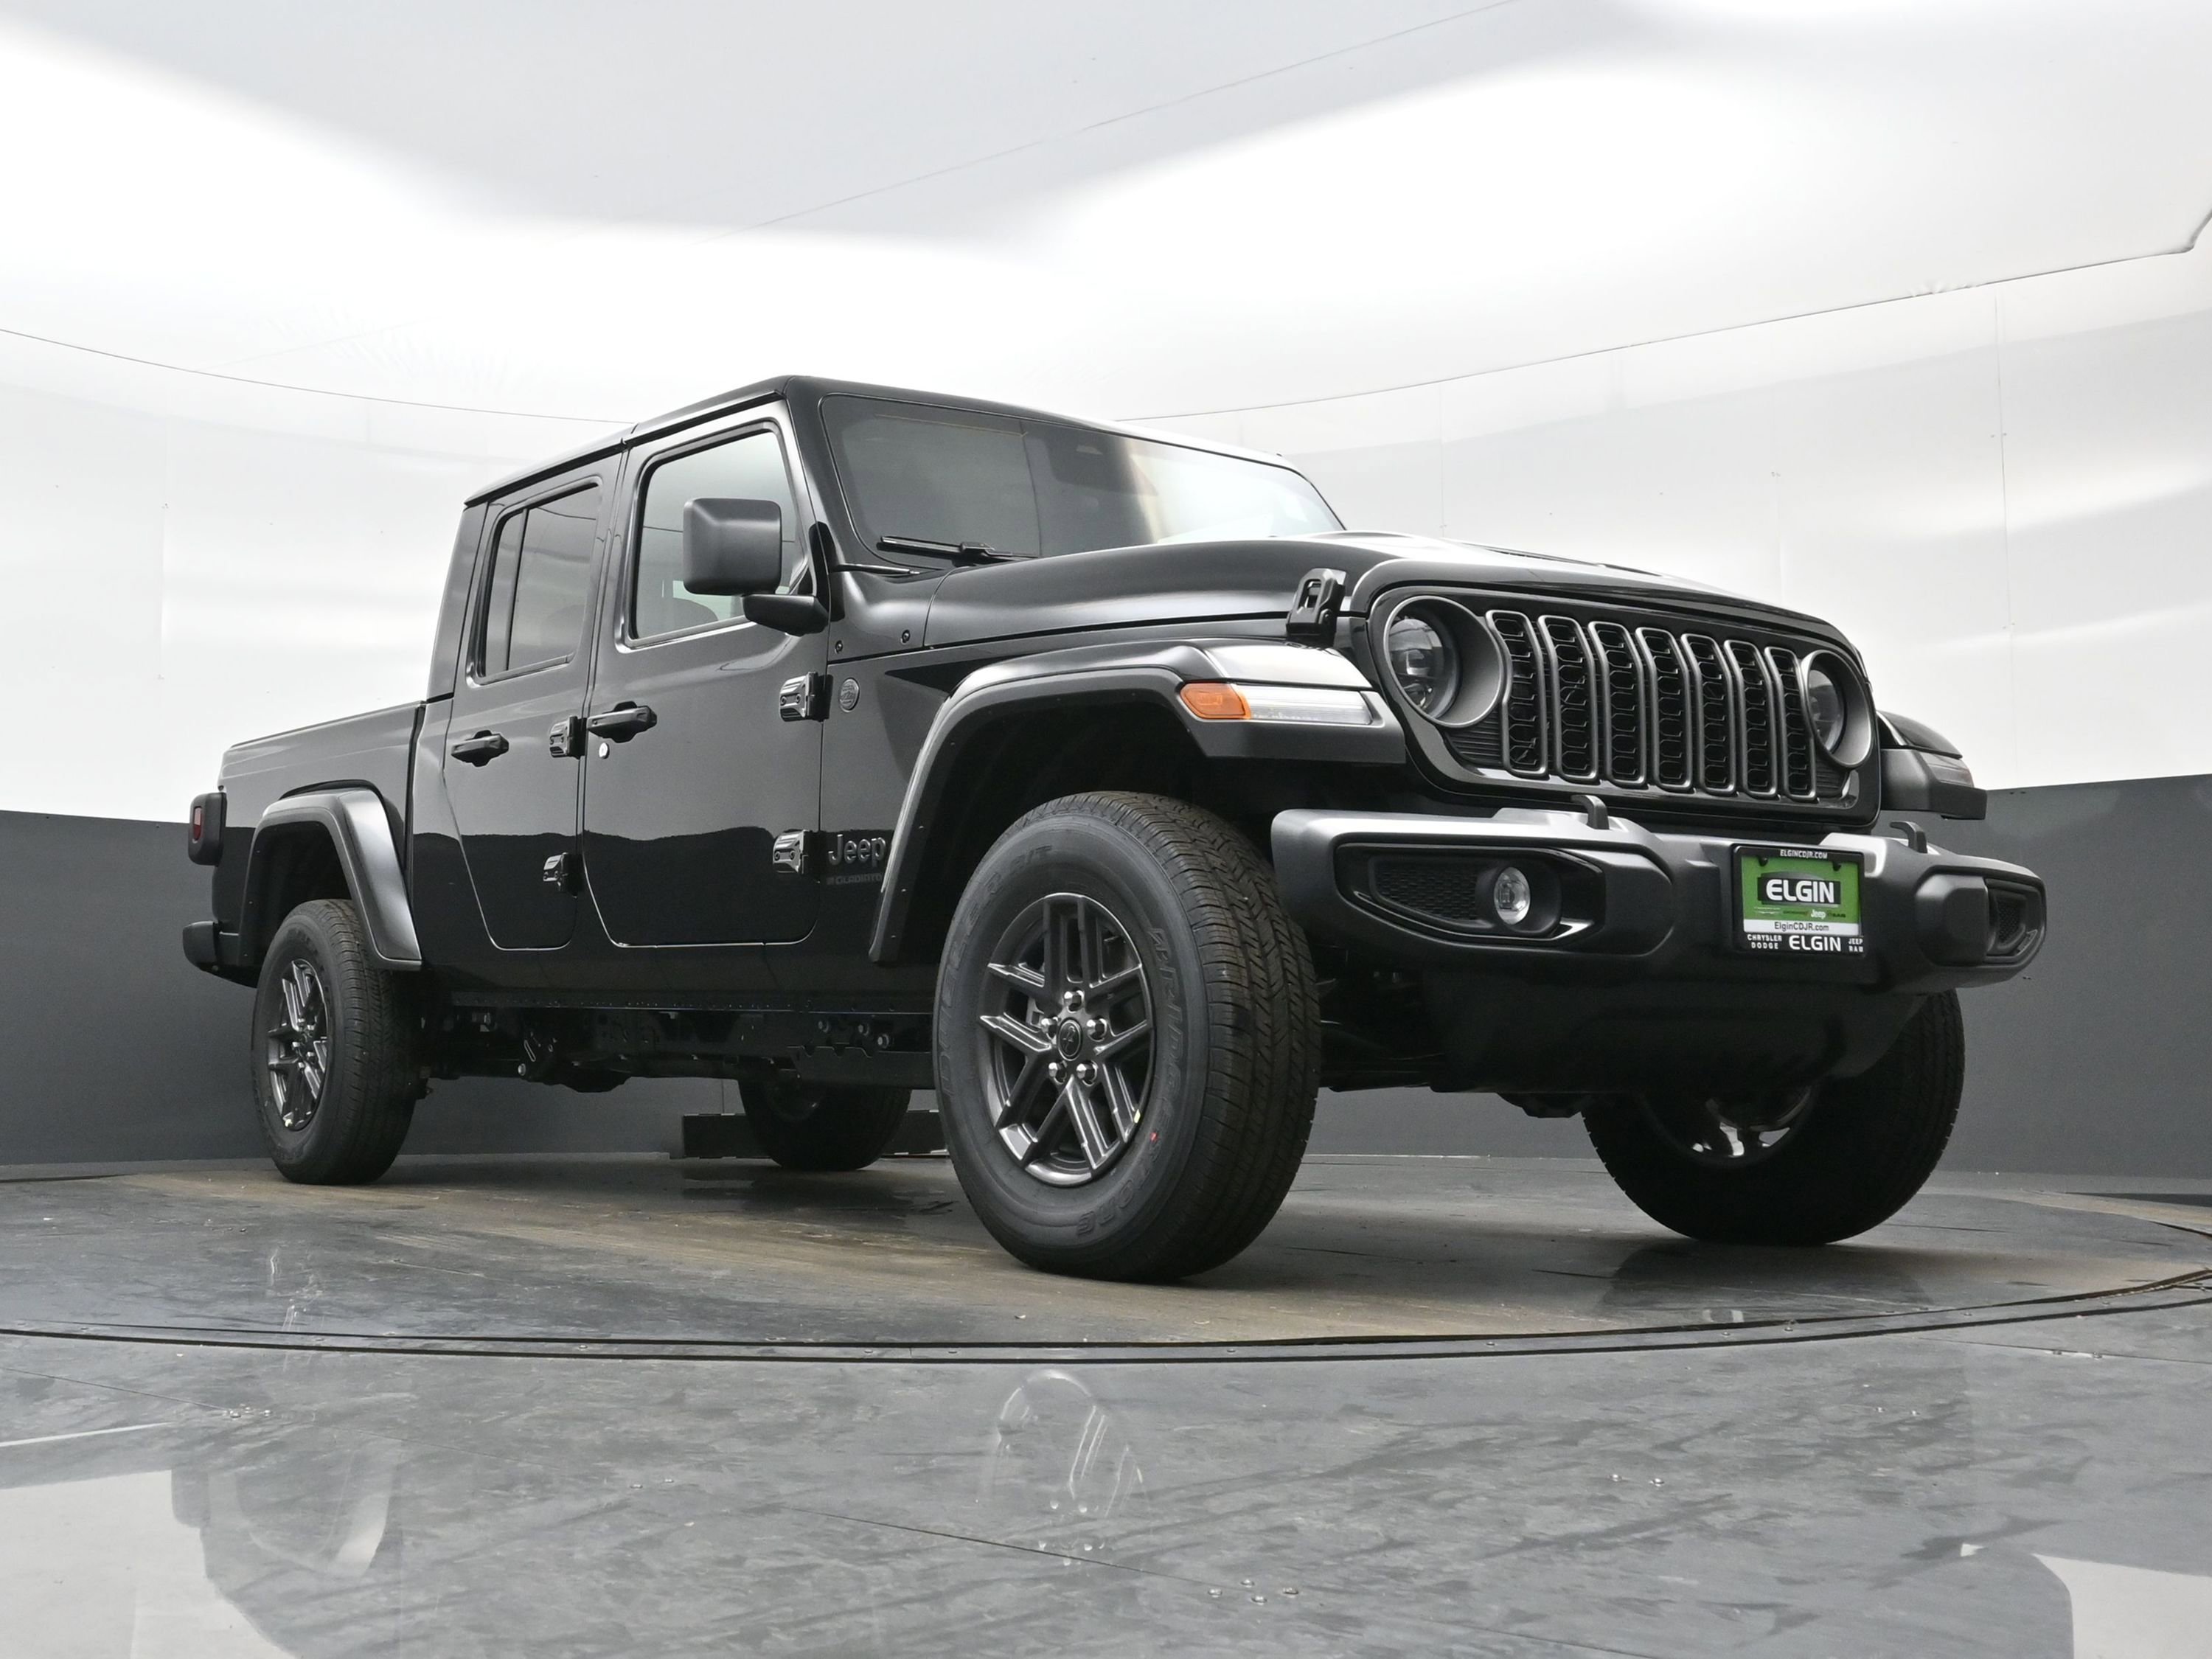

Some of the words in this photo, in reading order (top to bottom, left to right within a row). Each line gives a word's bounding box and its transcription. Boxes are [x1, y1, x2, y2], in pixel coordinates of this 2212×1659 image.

[828, 834, 886, 867] Jeep
[1780, 849, 1828, 860] ELGINCDJR.COM
[835, 873, 883, 885] GLADIATO
[1766, 879, 1834, 903] ELGIN
[1774, 922, 1829, 932] ElginCDJR.com
[1747, 933, 1782, 942] CHRYSLER
[1789, 935, 1841, 952] ELGIN
